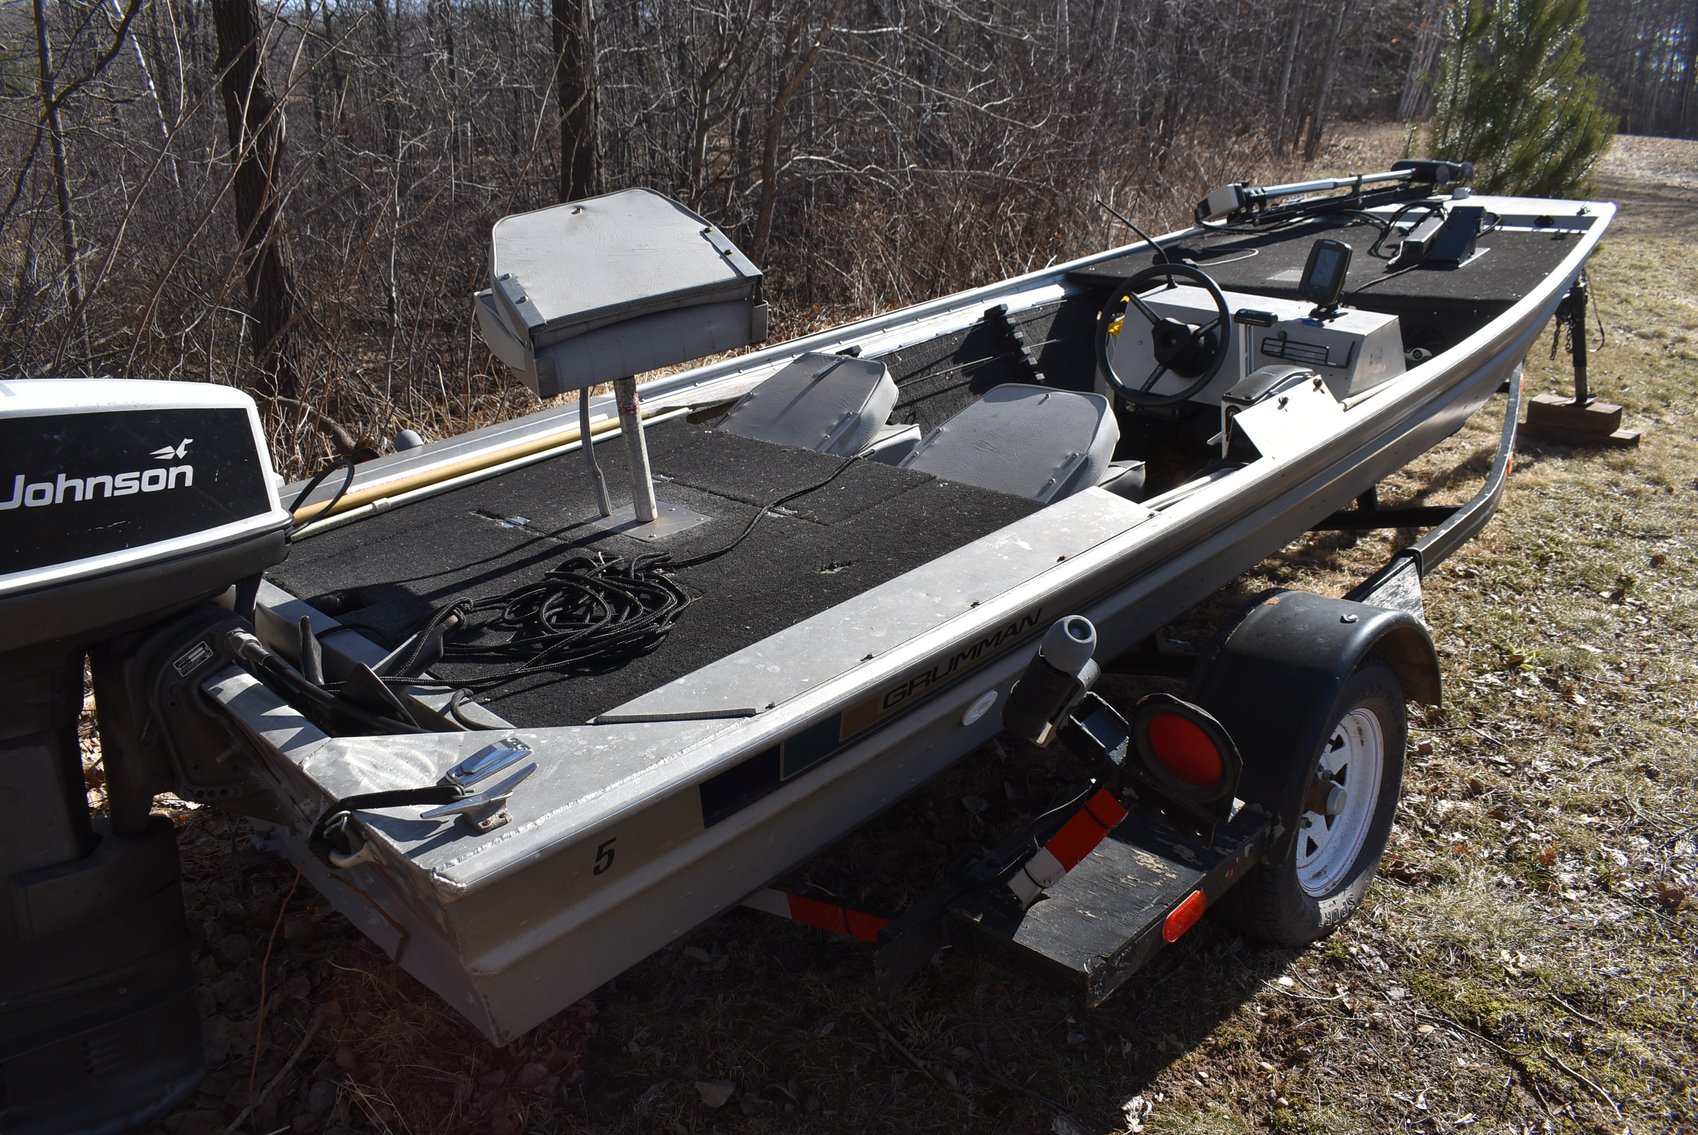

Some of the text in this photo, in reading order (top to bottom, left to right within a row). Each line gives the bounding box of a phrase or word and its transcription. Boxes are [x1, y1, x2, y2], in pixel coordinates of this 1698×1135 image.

[0, 464, 194, 511] Johnson
[882, 607, 1043, 710] GRUMMAN
[593, 836, 617, 876] 5
